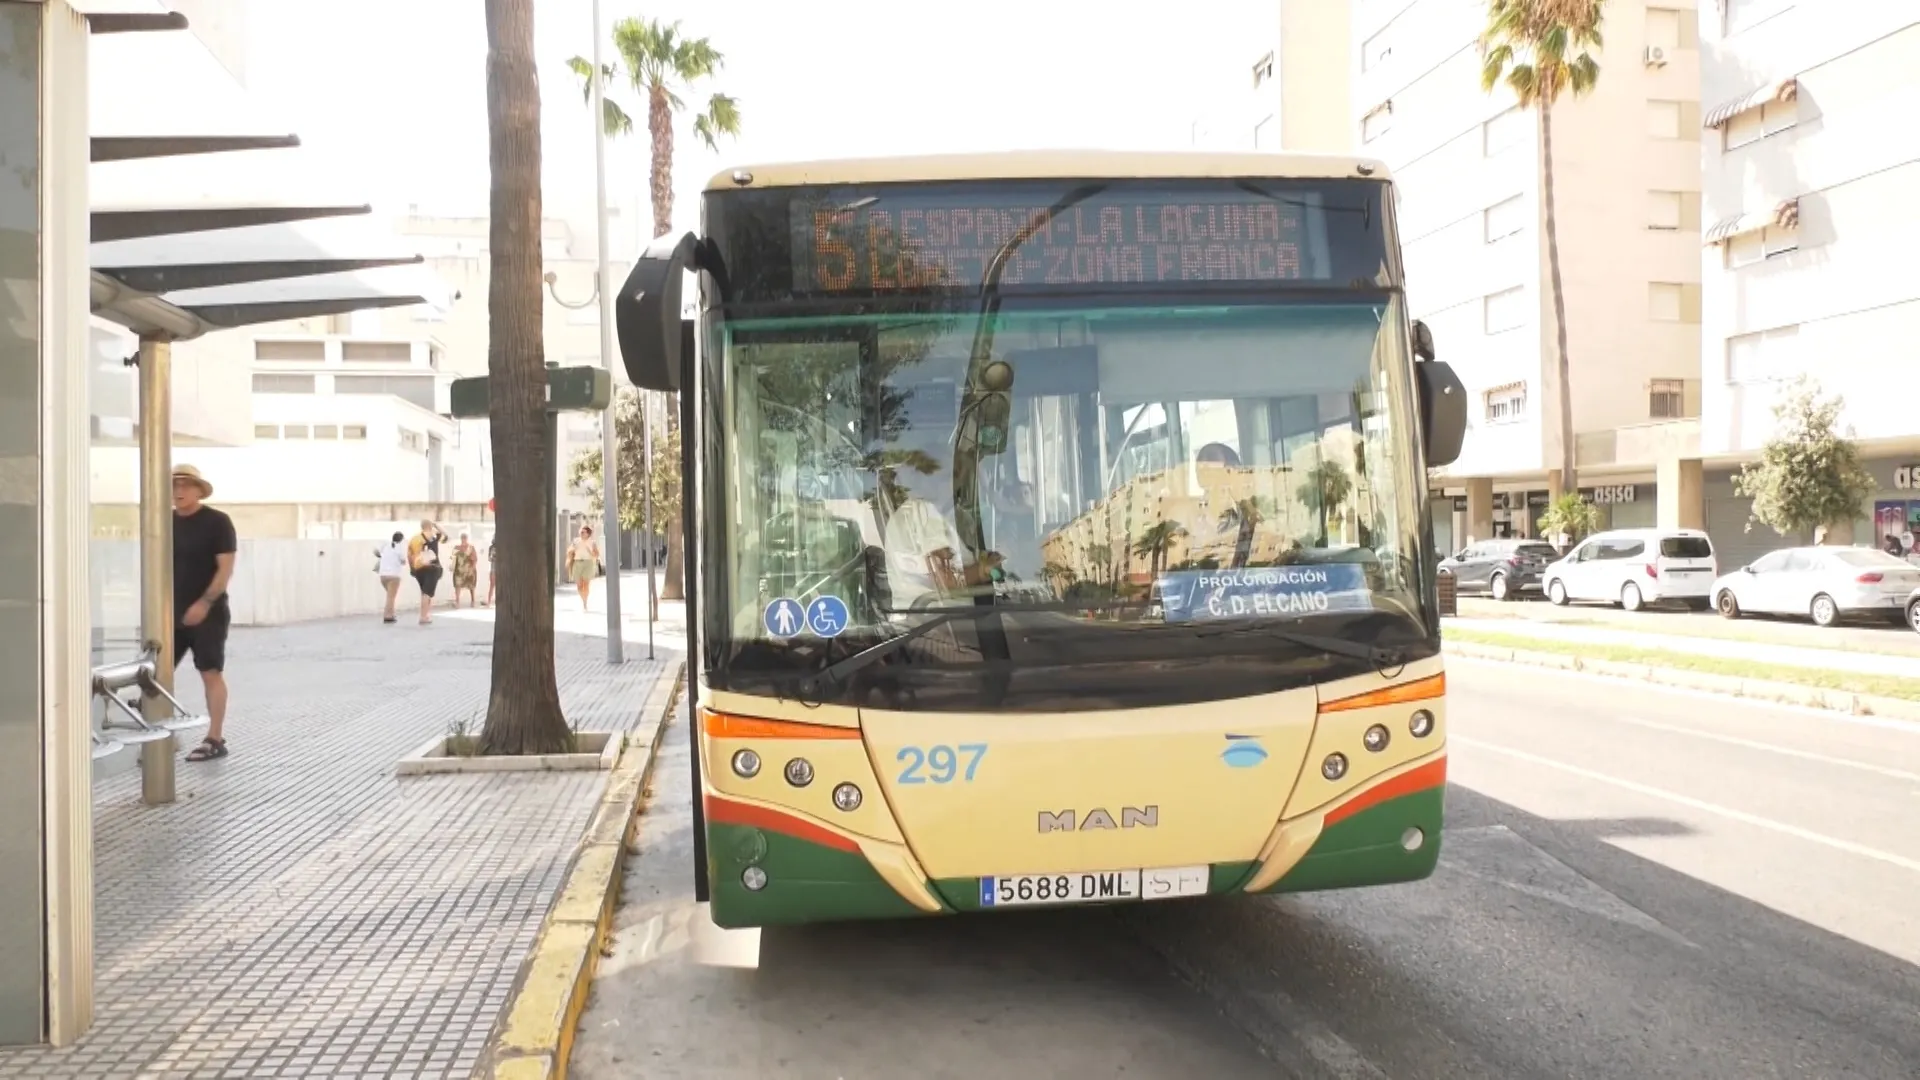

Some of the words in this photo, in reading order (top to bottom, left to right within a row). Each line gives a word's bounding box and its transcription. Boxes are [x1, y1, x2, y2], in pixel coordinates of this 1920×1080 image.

[814, 207, 858, 290] 5
[1157, 242, 1299, 281] FRANCA
[1594, 484, 1635, 505] asisa
[1208, 596, 1229, 617] C.
[1231, 594, 1251, 615] D.
[1253, 590, 1329, 614] ELCANO
[896, 742, 988, 784] 297
[1037, 804, 1159, 834] MAN
[999, 875, 1070, 902] 5688
[1081, 872, 1132, 899] DML
